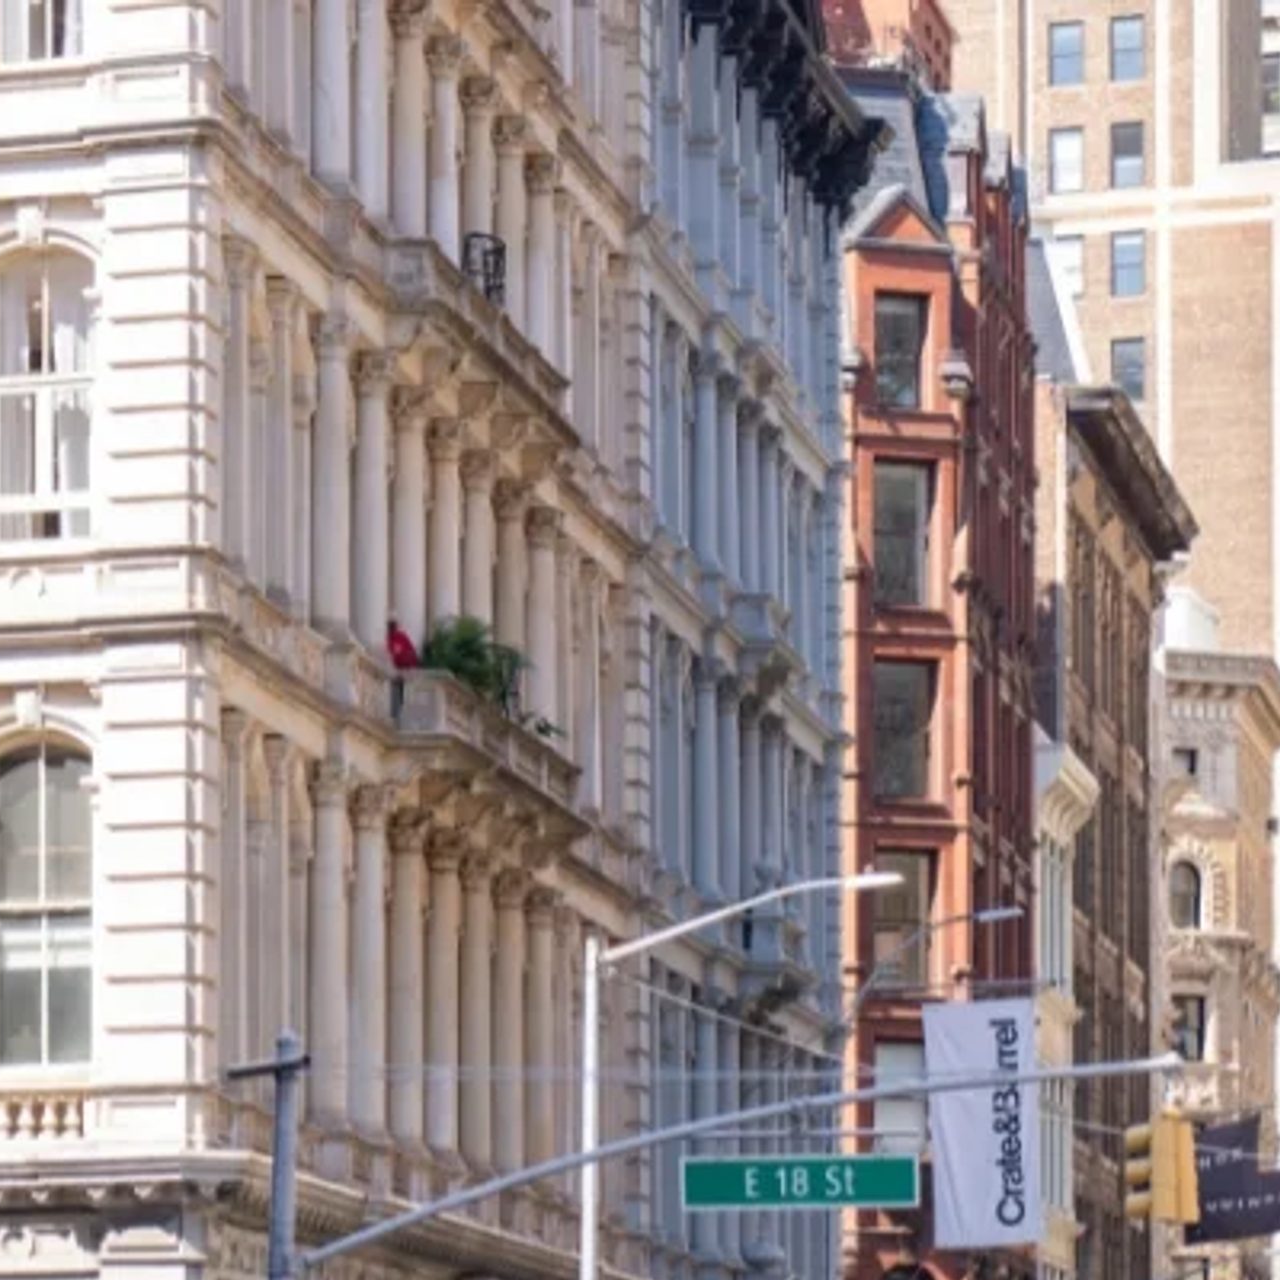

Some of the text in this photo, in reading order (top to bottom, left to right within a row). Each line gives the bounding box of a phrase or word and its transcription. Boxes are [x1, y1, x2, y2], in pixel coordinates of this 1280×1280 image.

[745, 1165, 856, 1198] E 18 St
